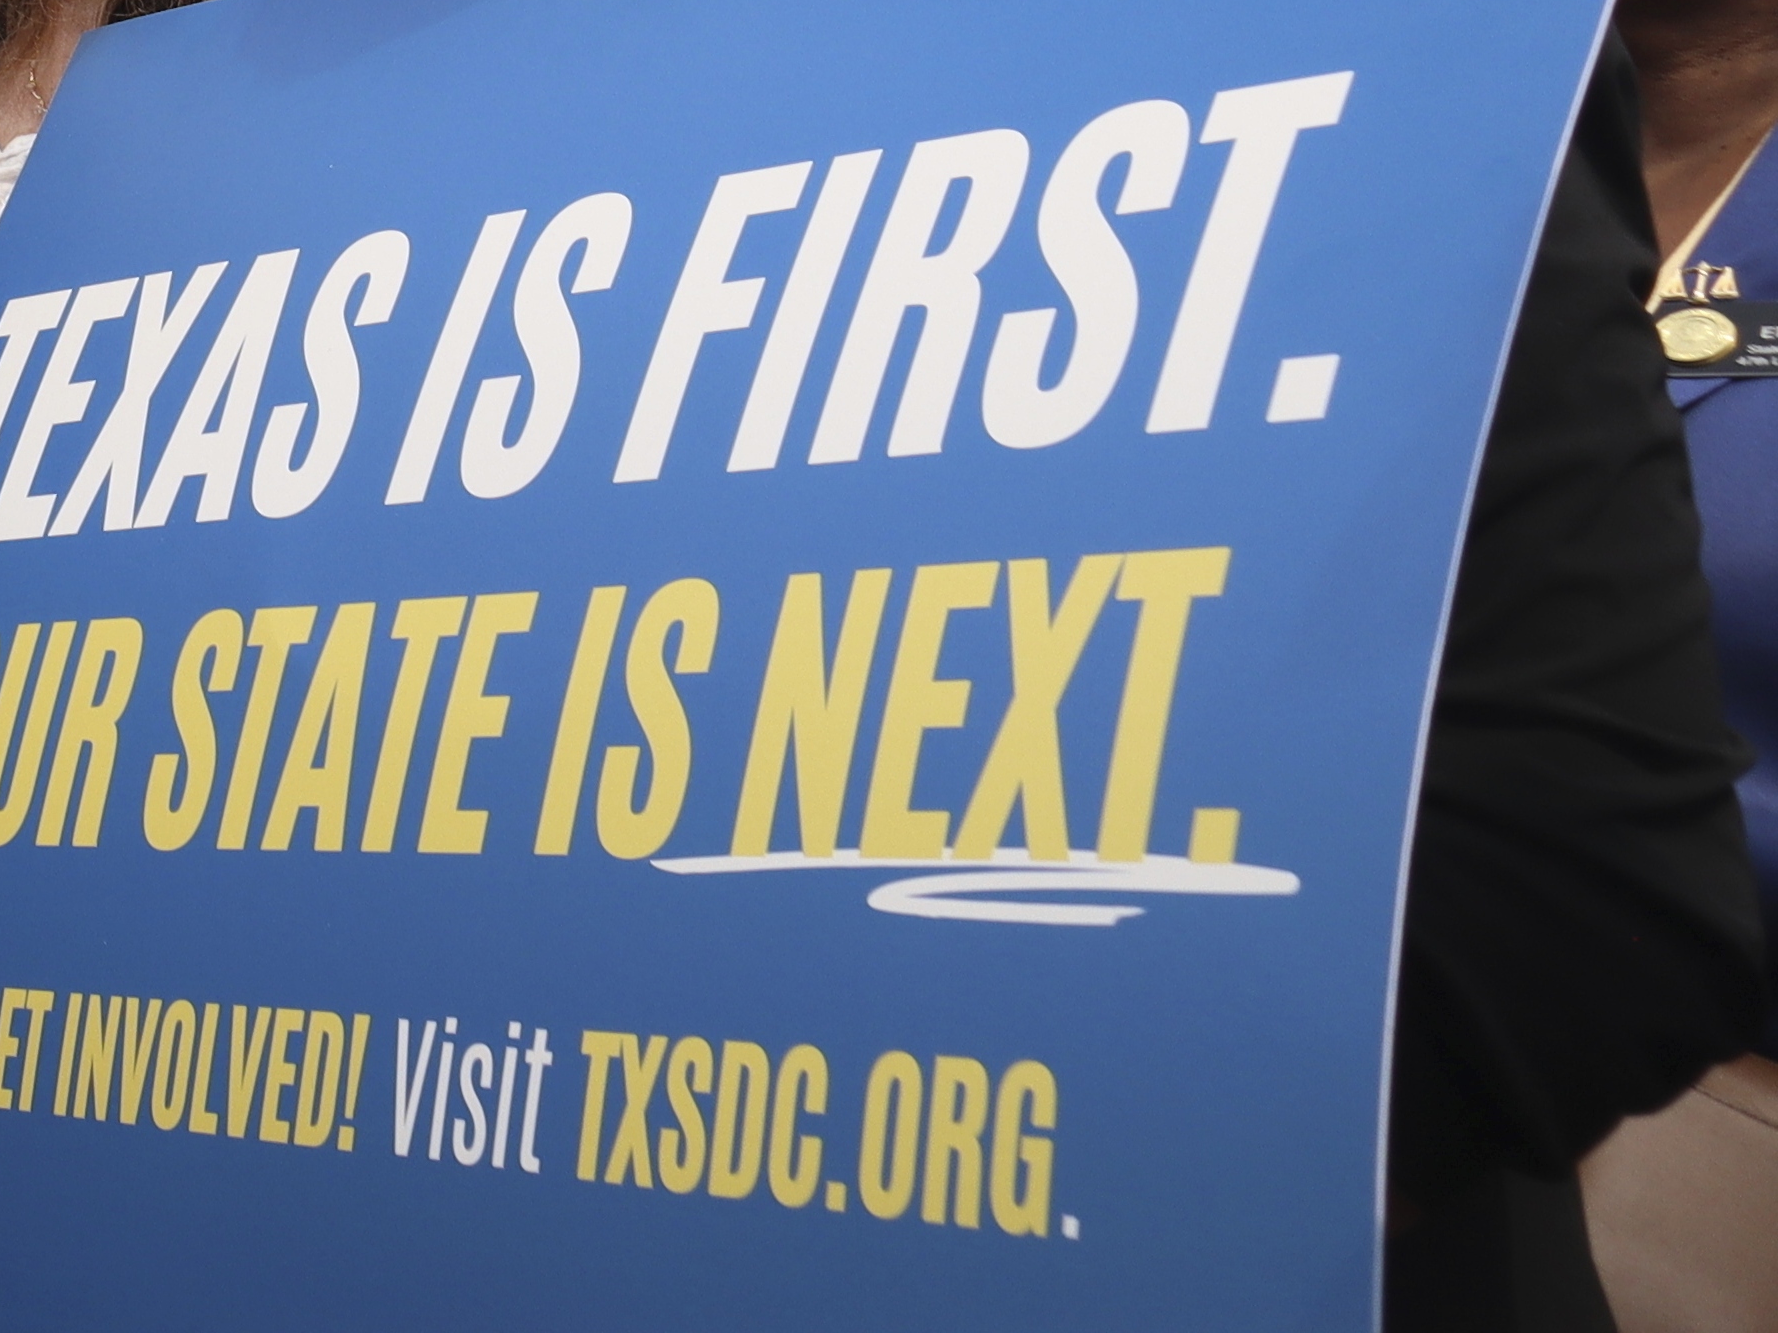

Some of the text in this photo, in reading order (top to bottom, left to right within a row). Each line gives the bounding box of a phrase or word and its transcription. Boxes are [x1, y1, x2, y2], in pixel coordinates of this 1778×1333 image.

[385, 191, 633, 506] IS
[611, 68, 1354, 486] FIRST.
[140, 590, 537, 859] STATE
[534, 577, 718, 861] IS
[730, 545, 1239, 866] NEXT.
[56, 993, 370, 1155] INVOLVED!
[390, 1016, 554, 1177] Visit
[575, 1025, 1083, 1242] TXSDC.ORG.
